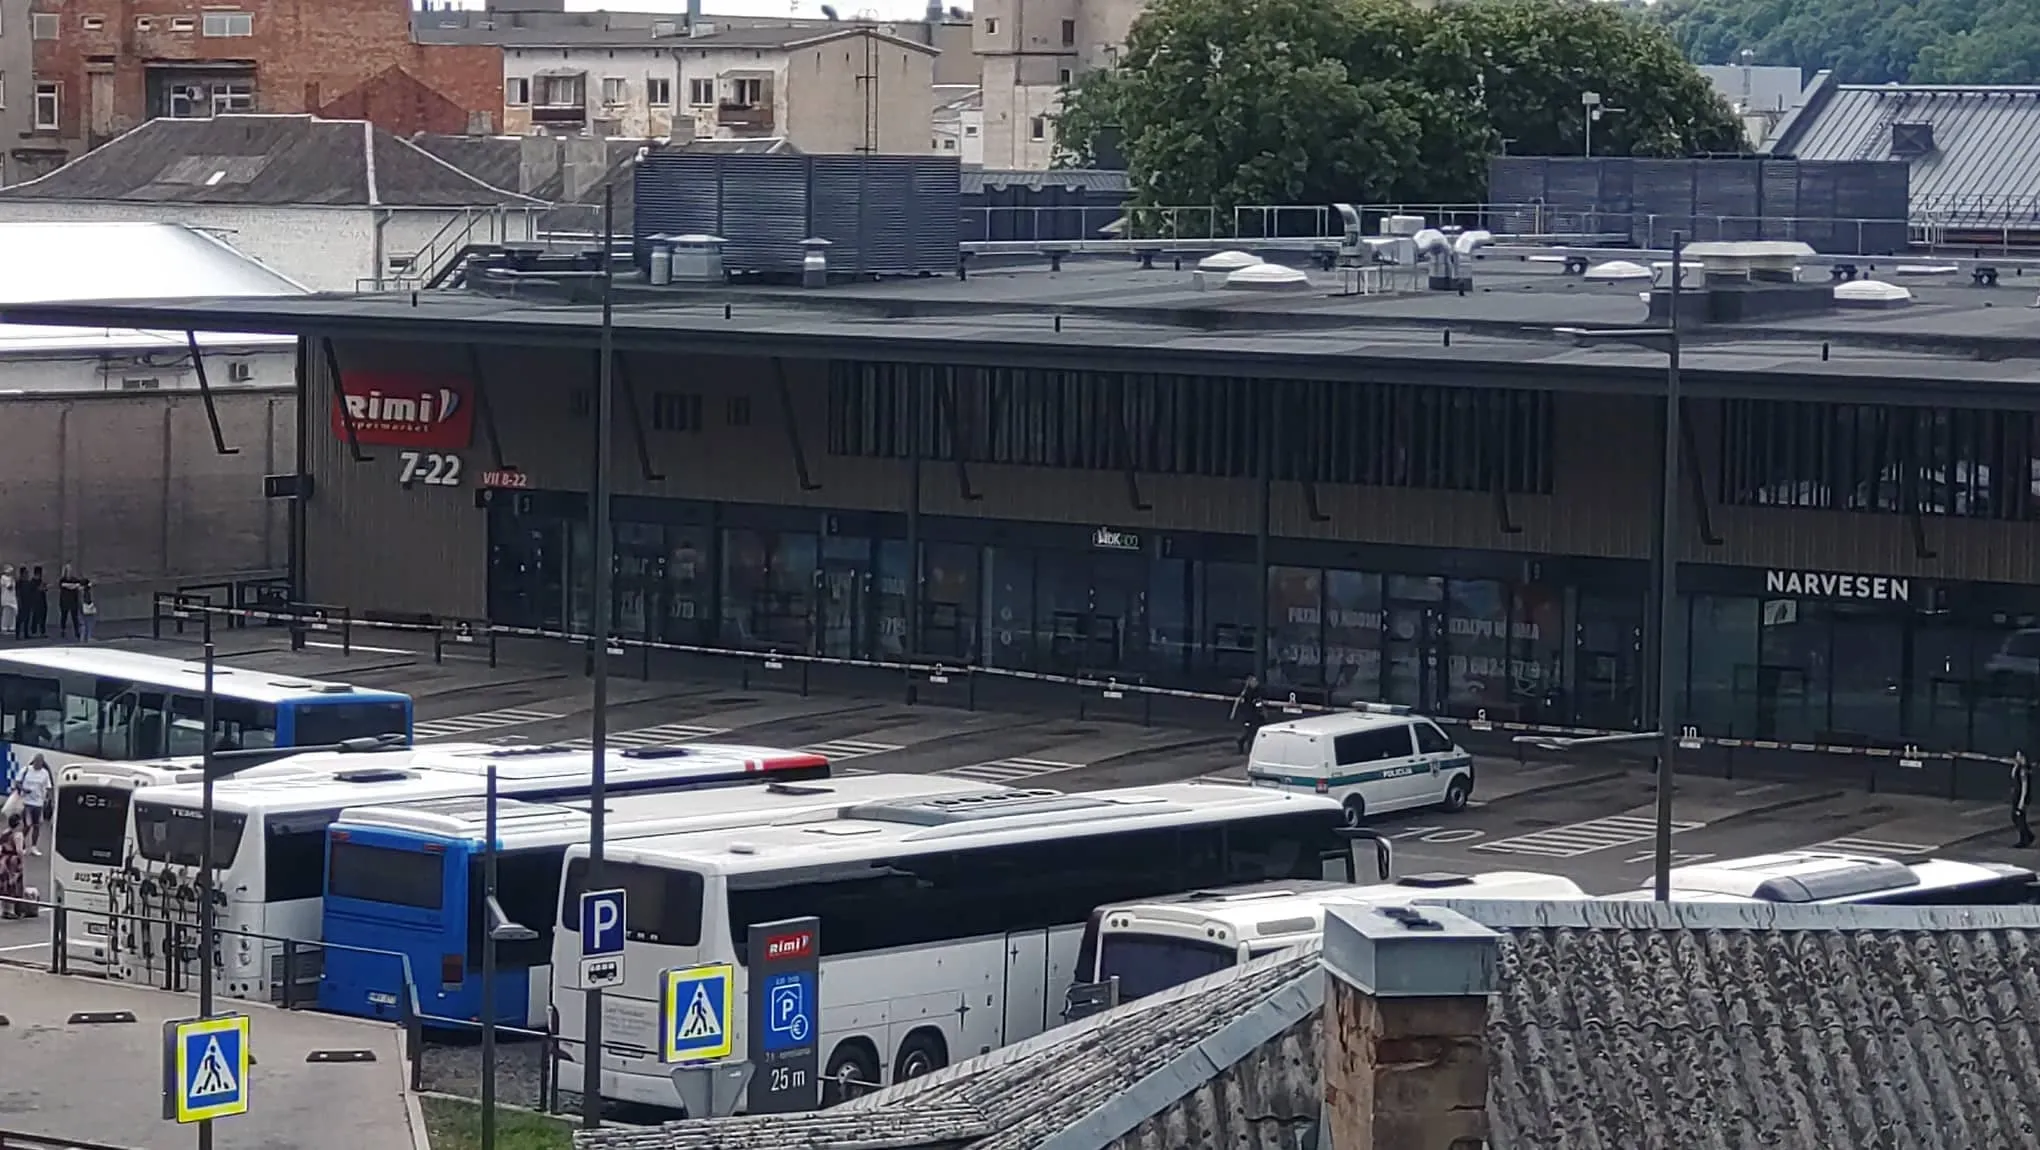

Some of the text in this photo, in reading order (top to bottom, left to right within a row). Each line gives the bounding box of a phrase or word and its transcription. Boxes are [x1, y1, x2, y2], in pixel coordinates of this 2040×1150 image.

[344, 390, 434, 423] Rimi
[399, 451, 460, 486] 7-22
[483, 471, 528, 487] VII 8-22
[1766, 570, 1910, 601] NARVESEN
[1682, 725, 1698, 740] 10
[1904, 744, 1918, 760] 11
[593, 899, 618, 949] P
[770, 937, 800, 953] Rimi
[782, 998, 794, 1021] P
[770, 1067, 805, 1092] 25 m
